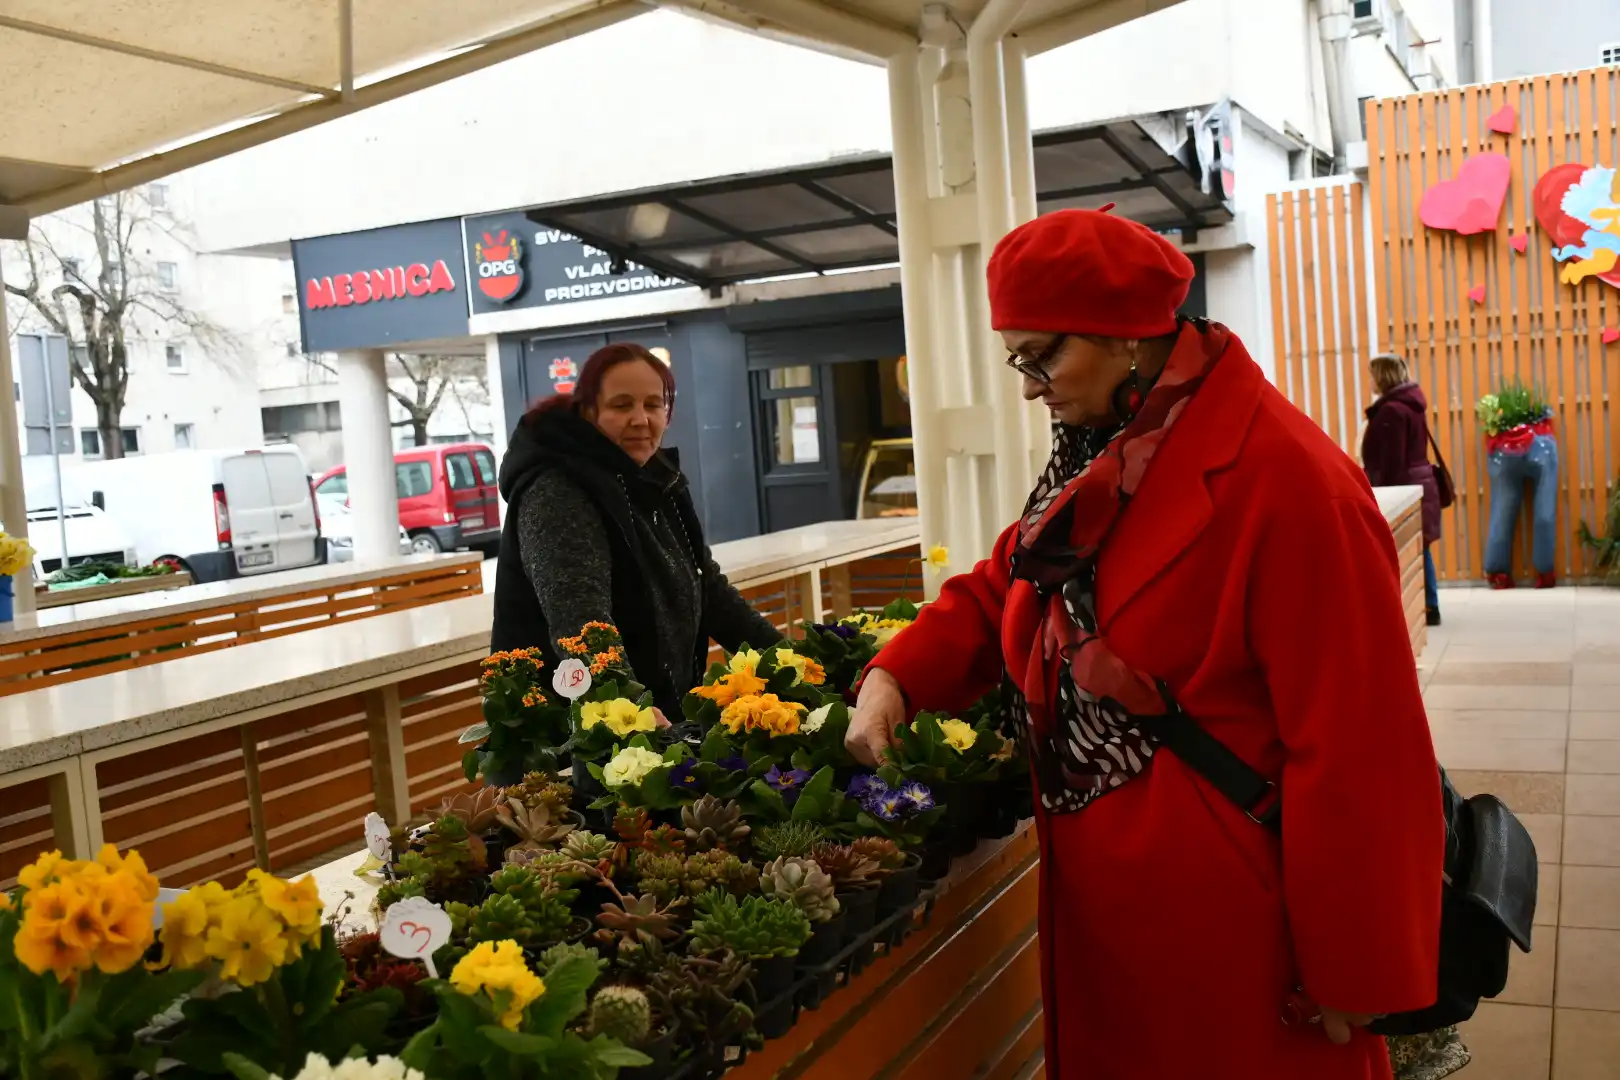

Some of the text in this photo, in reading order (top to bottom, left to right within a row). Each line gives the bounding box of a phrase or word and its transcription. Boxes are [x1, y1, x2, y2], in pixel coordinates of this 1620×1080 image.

[306, 259, 455, 309] MESNICA
[479, 260, 516, 278] OPG
[399, 920, 432, 953] 3
